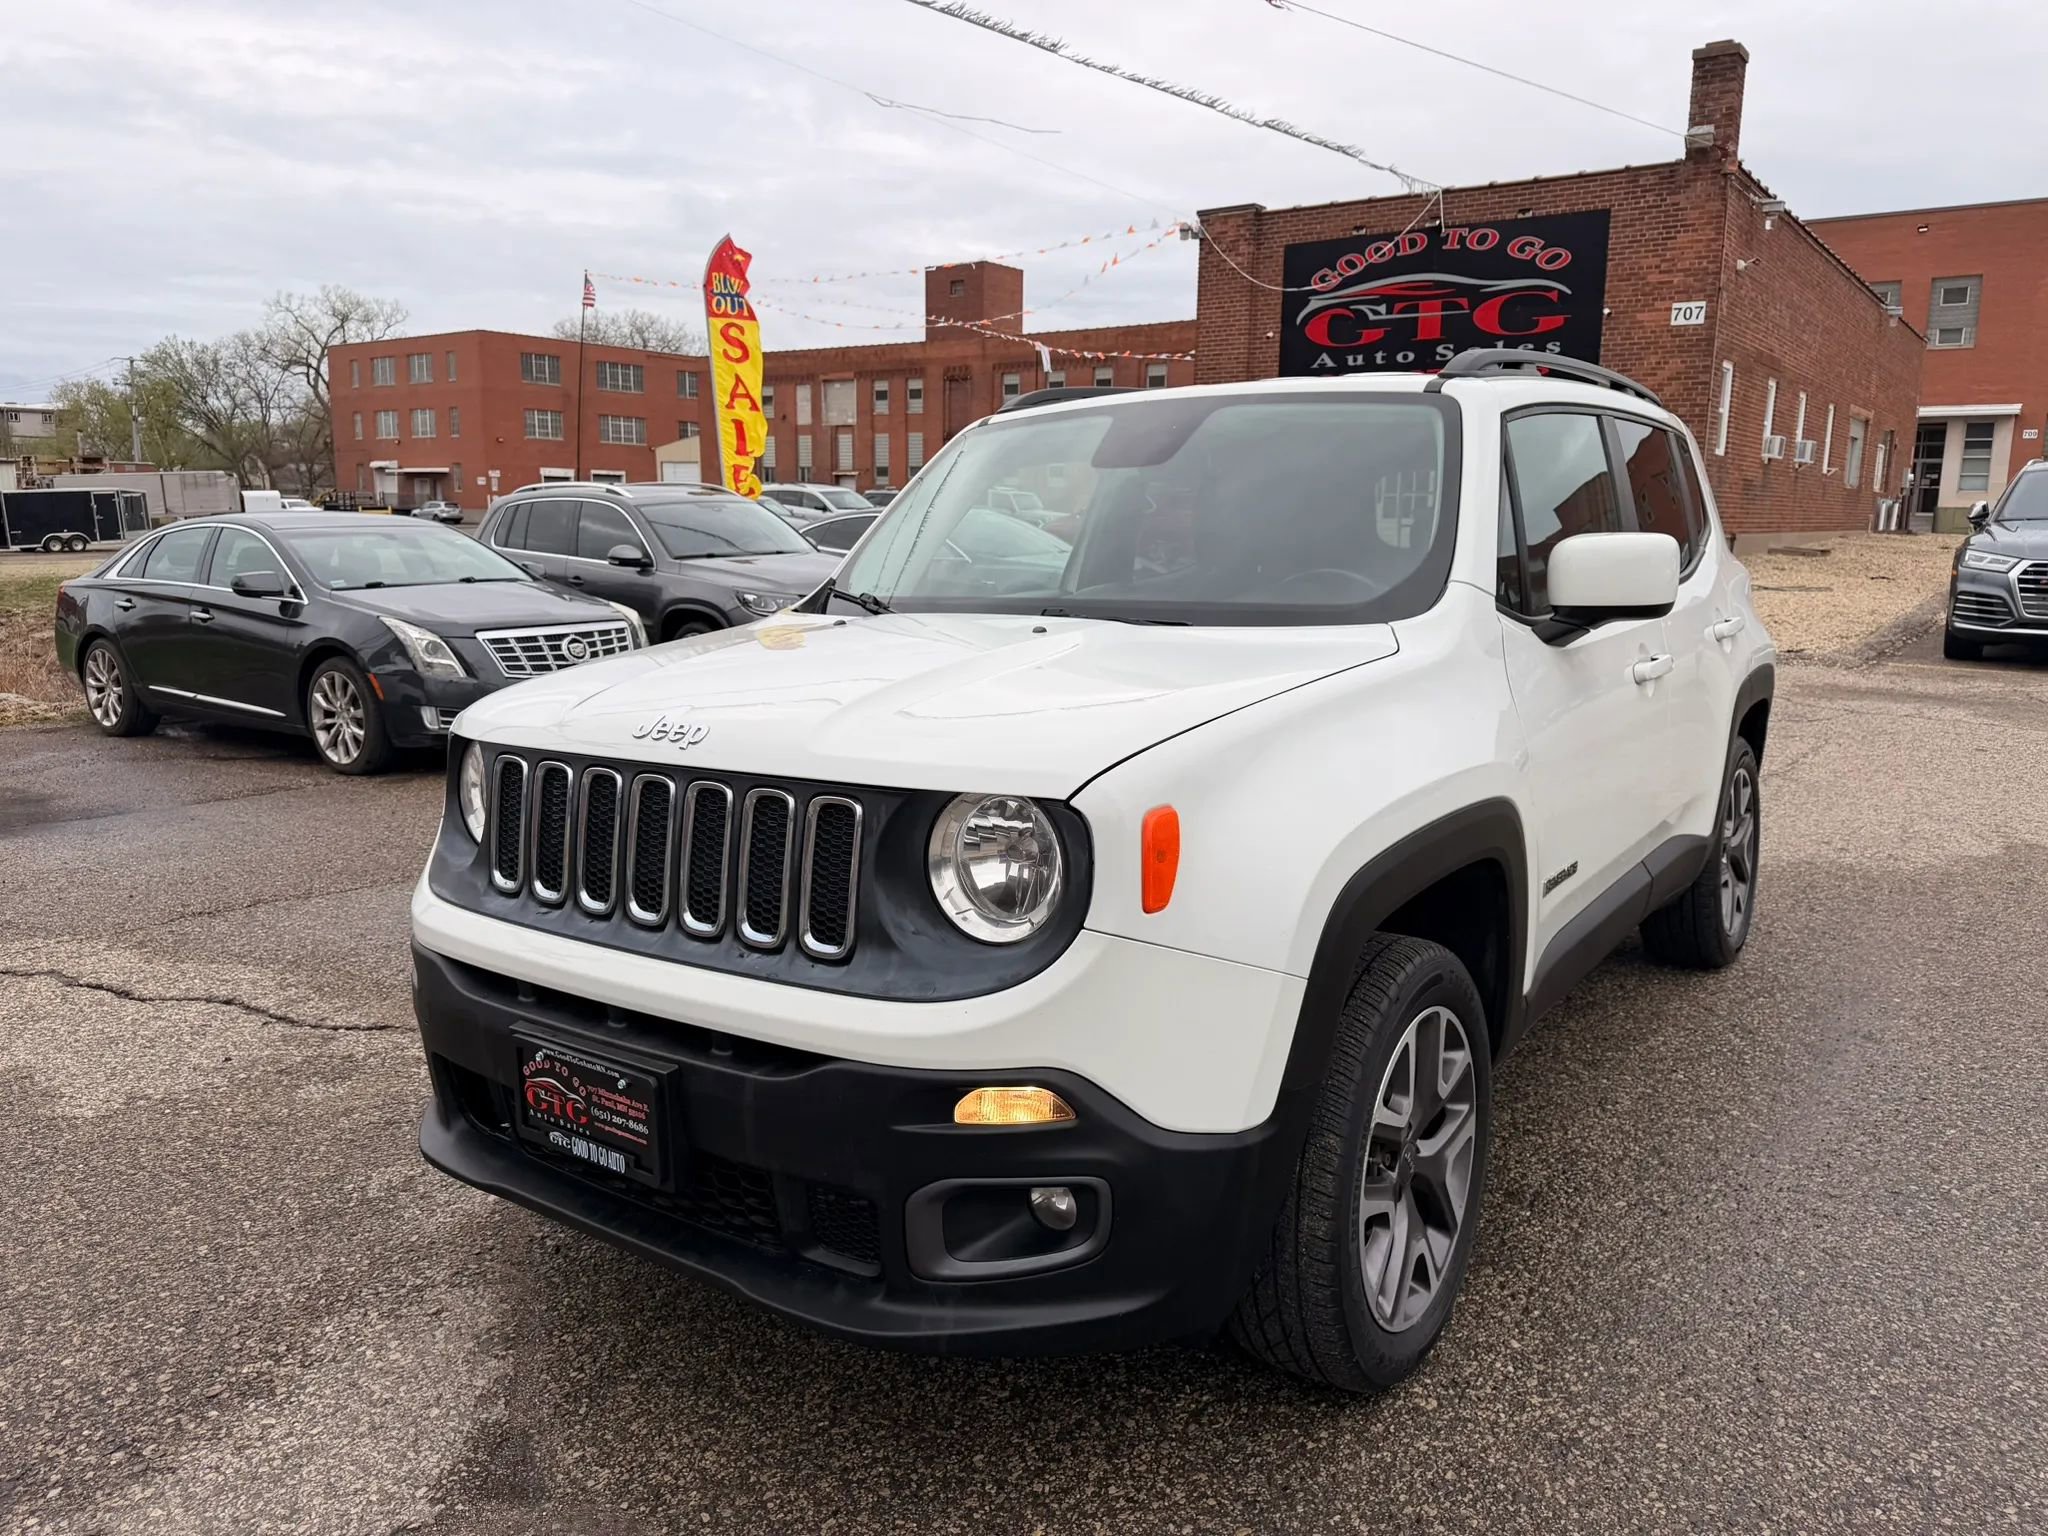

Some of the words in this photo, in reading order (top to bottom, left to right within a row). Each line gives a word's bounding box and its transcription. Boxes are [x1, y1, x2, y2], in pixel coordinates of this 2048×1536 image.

[1311, 232, 1428, 291] GOOD
[1441, 228, 1500, 250] TO
[1507, 235, 1572, 270] GO
[711, 296, 749, 317] OUT
[1304, 290, 1572, 348] GTG
[1673, 305, 1704, 321] 707
[1310, 350, 1416, 369] Auto
[1436, 340, 1562, 362] Sles
[720, 322, 761, 498] SALE
[632, 714, 711, 751] Jeep
[522, 1060, 551, 1076] GOOD
[554, 1061, 569, 1077] TO
[572, 1076, 587, 1097] GO
[590, 1105, 611, 1122] (651)
[611, 1115, 649, 1135] 207-8686
[571, 1136, 589, 1159] GOOD
[588, 1142, 598, 1163] TO
[598, 1146, 608, 1167] GO
[607, 1150, 626, 1174] AUTO
